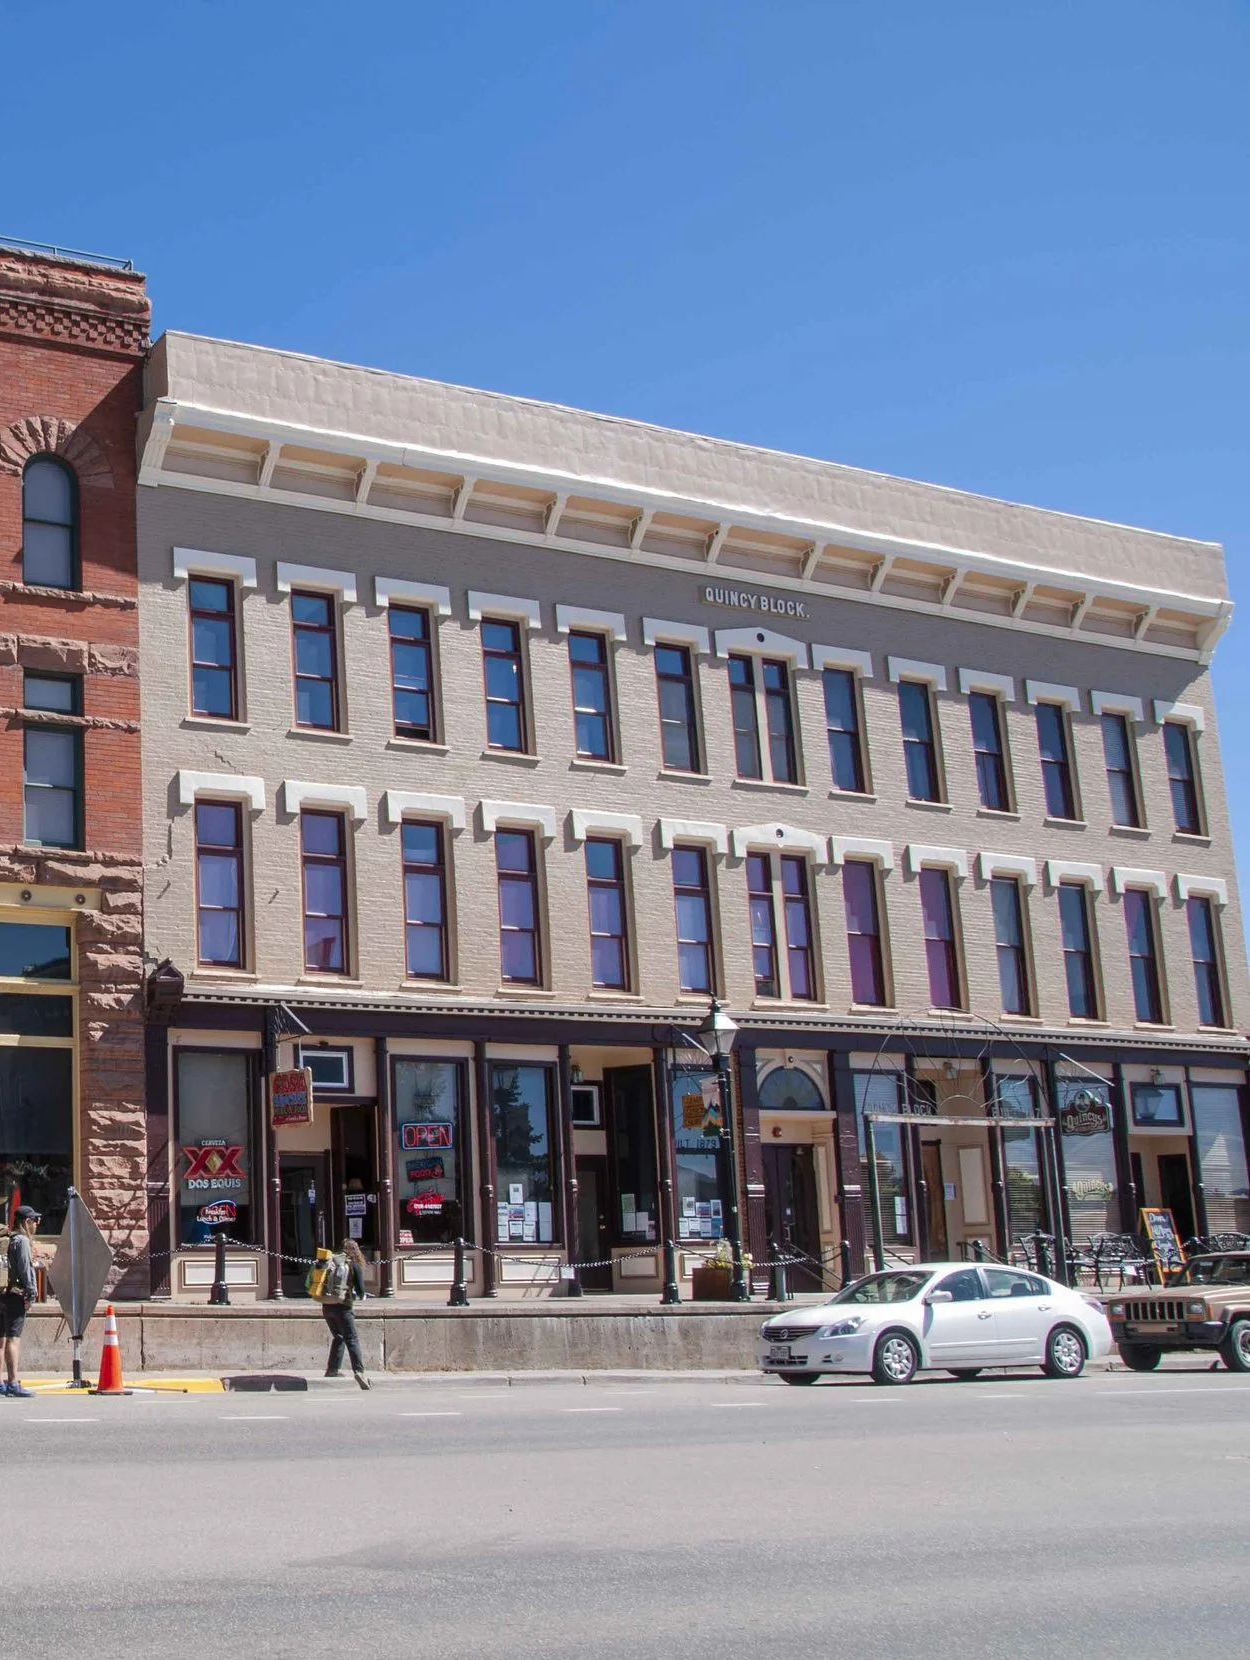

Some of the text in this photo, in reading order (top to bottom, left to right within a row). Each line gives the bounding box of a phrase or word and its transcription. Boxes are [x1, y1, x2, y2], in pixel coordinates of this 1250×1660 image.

[705, 587, 757, 609] QUINCY
[273, 1072, 306, 1093] CASA
[404, 1126, 450, 1147] OPEN
[696, 1139, 717, 1148] 1879
[182, 1146, 247, 1179] XX
[188, 1178, 242, 1189] DOS EQUIS
[410, 1169, 431, 1179] FOOD
